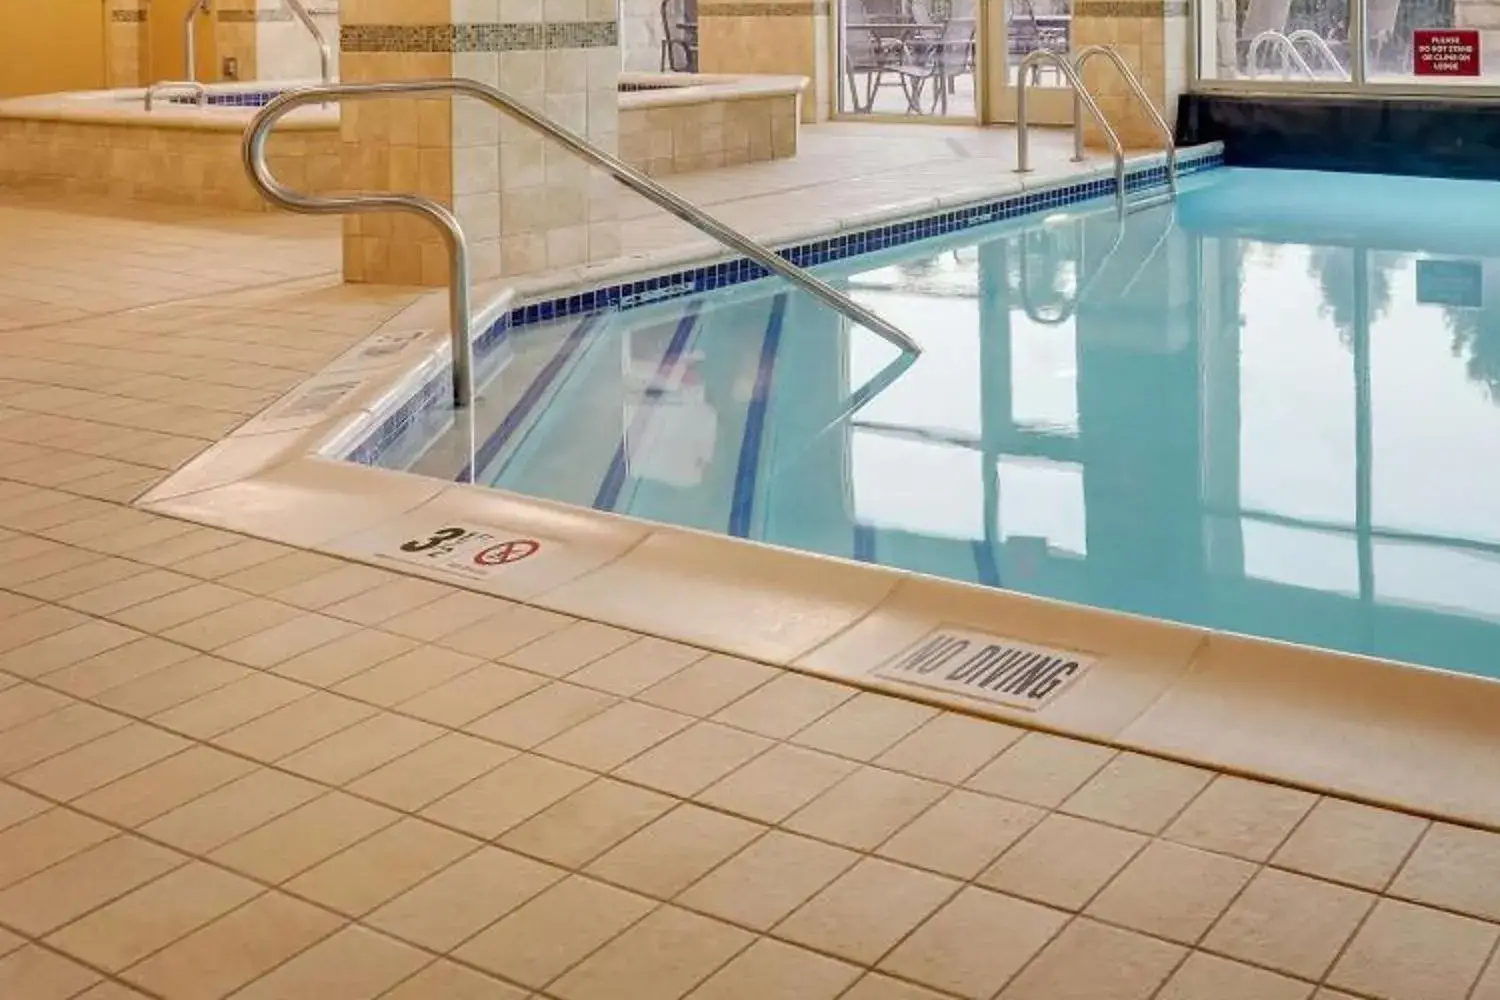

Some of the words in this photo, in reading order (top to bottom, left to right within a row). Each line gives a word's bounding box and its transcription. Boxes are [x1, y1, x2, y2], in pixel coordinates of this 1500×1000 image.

[400, 527, 466, 552] 3
[895, 634, 970, 674] NO
[945, 644, 1080, 699] DIVING
